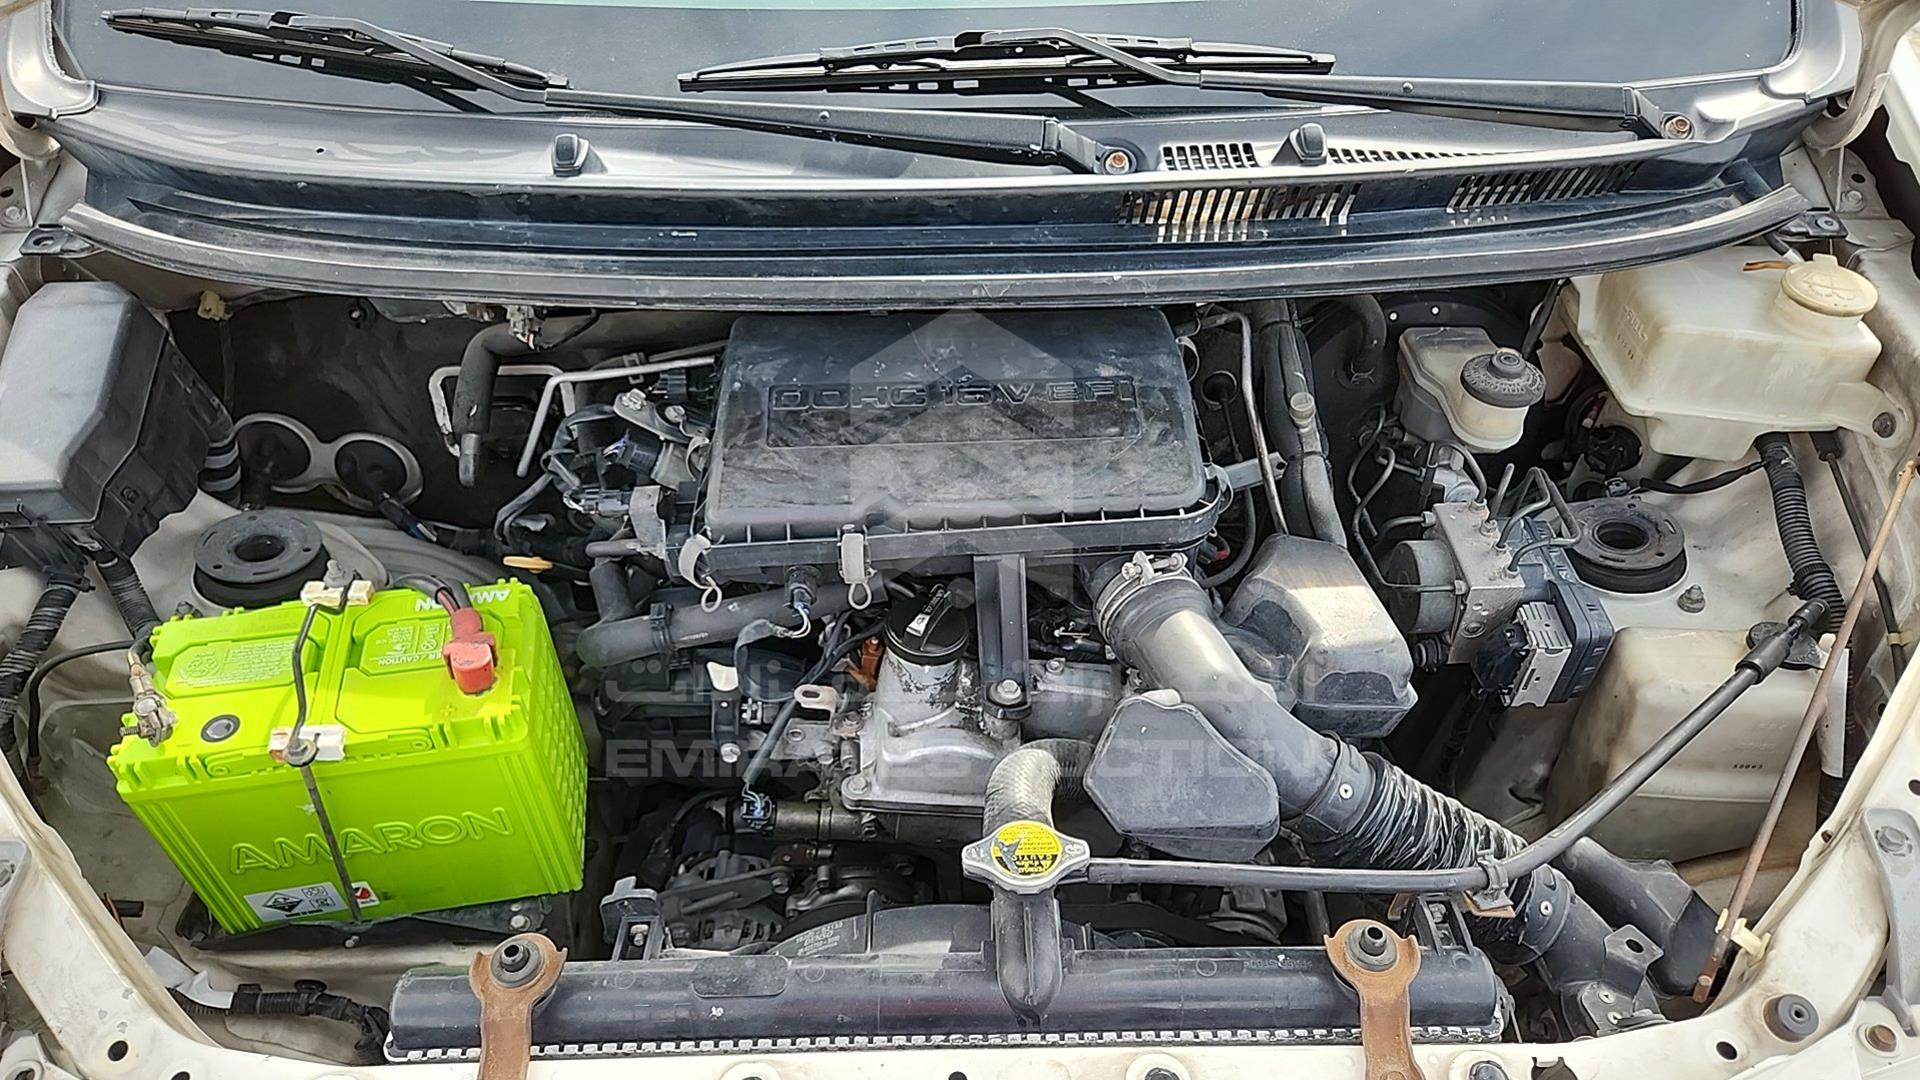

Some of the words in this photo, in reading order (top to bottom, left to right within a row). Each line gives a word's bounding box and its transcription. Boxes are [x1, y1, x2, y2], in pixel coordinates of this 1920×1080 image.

[773, 385, 927, 410] DOHC
[1047, 380, 1135, 403] EFI
[378, 653, 420, 667] CAUTION
[230, 807, 514, 874] AMARON
